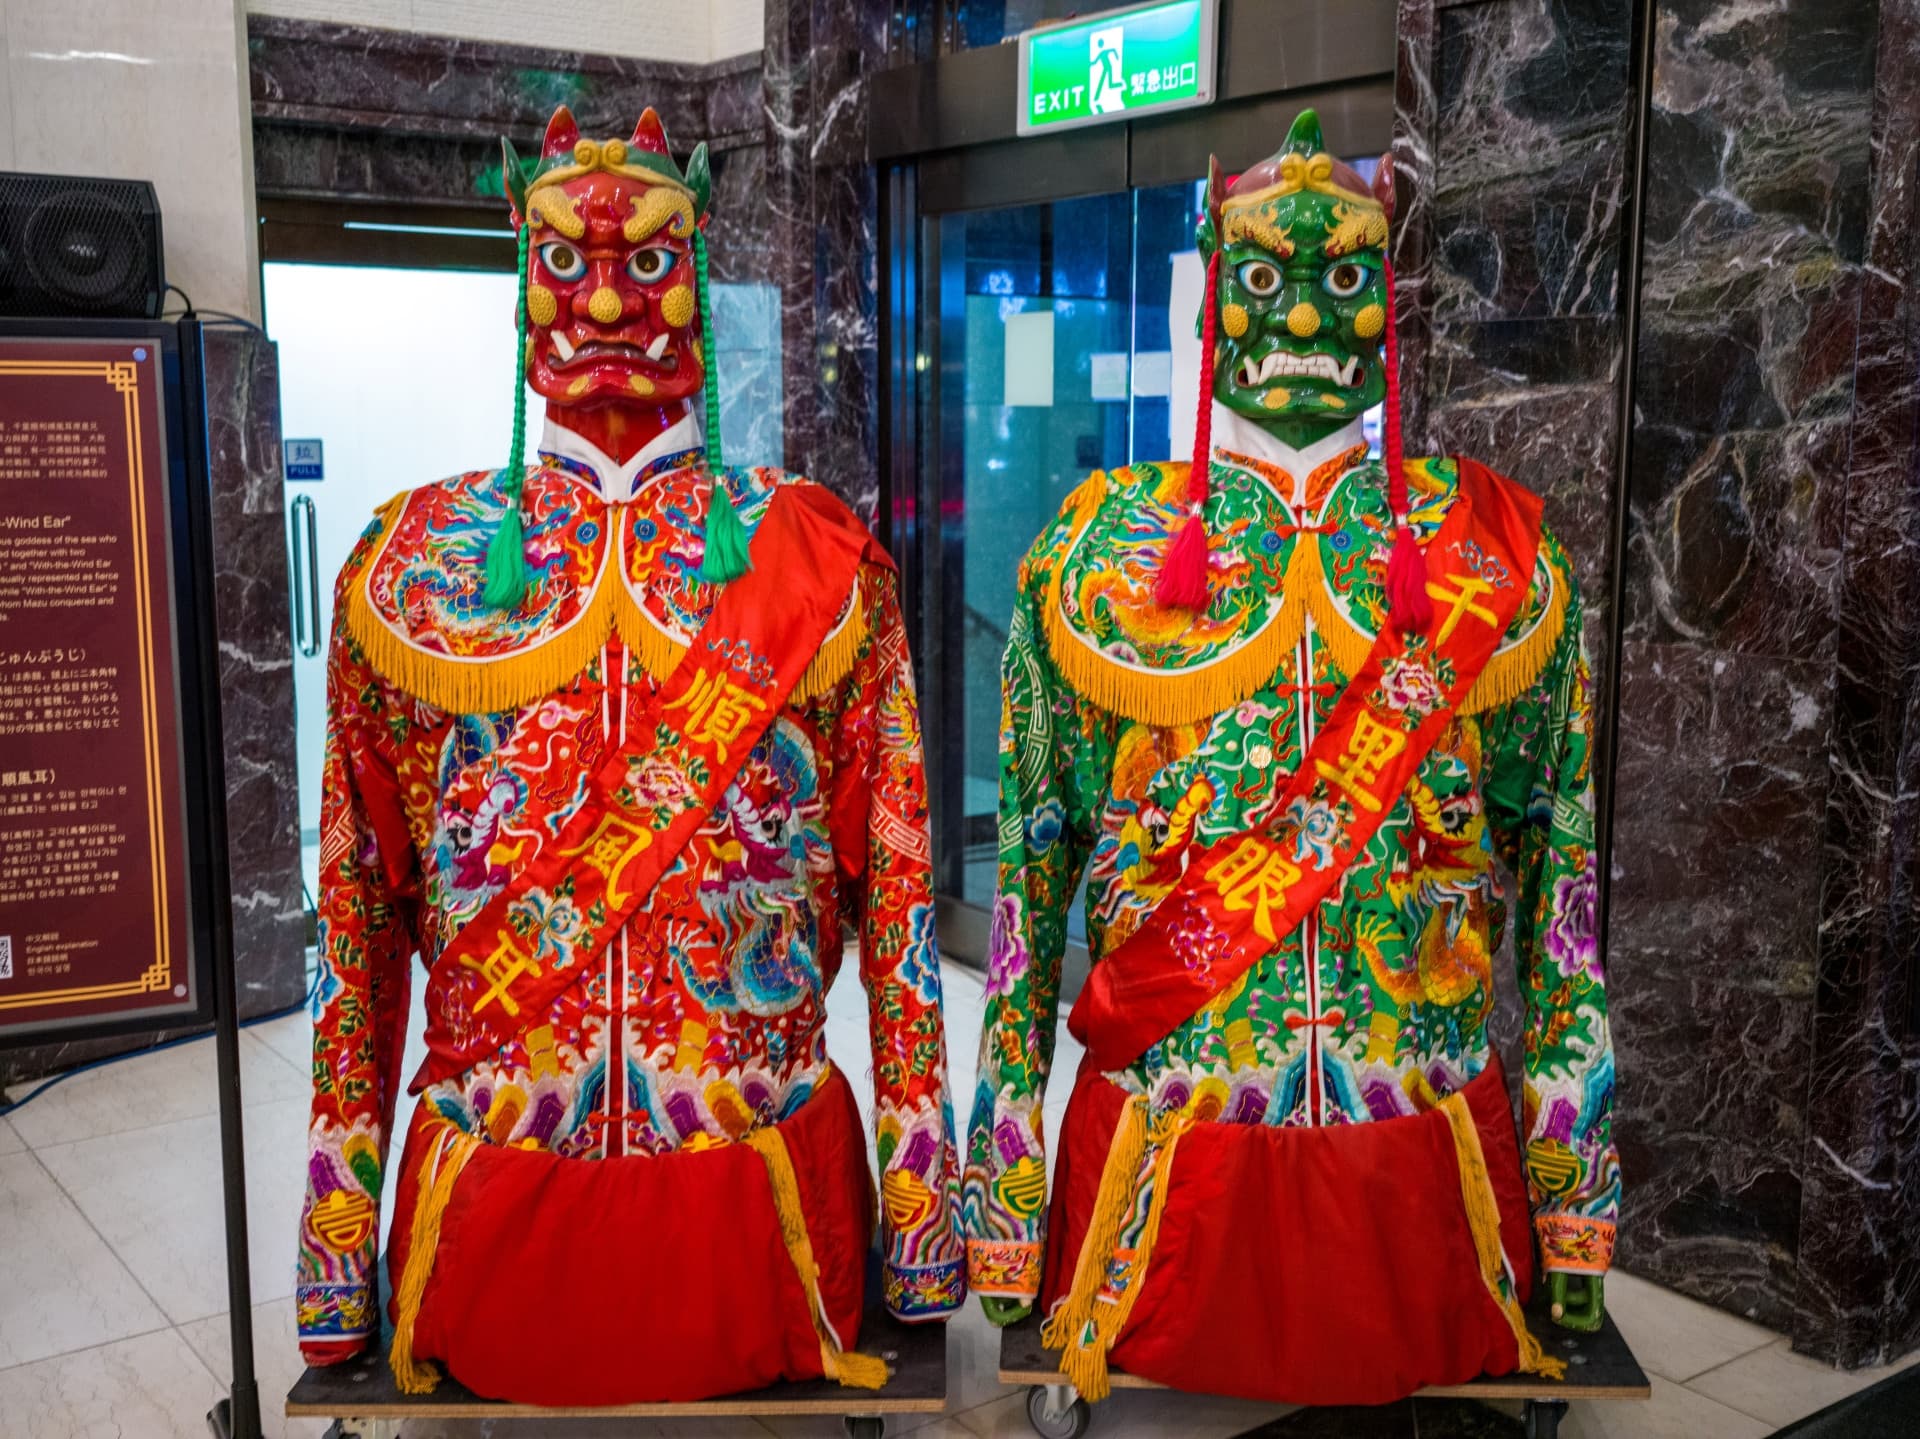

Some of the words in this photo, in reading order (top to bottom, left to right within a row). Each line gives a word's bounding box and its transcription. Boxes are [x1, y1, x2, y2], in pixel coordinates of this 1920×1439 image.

[1131, 62, 1196, 97] 緊急出口
[1034, 86, 1085, 115] EXIT
[291, 466, 317, 475] PULL
